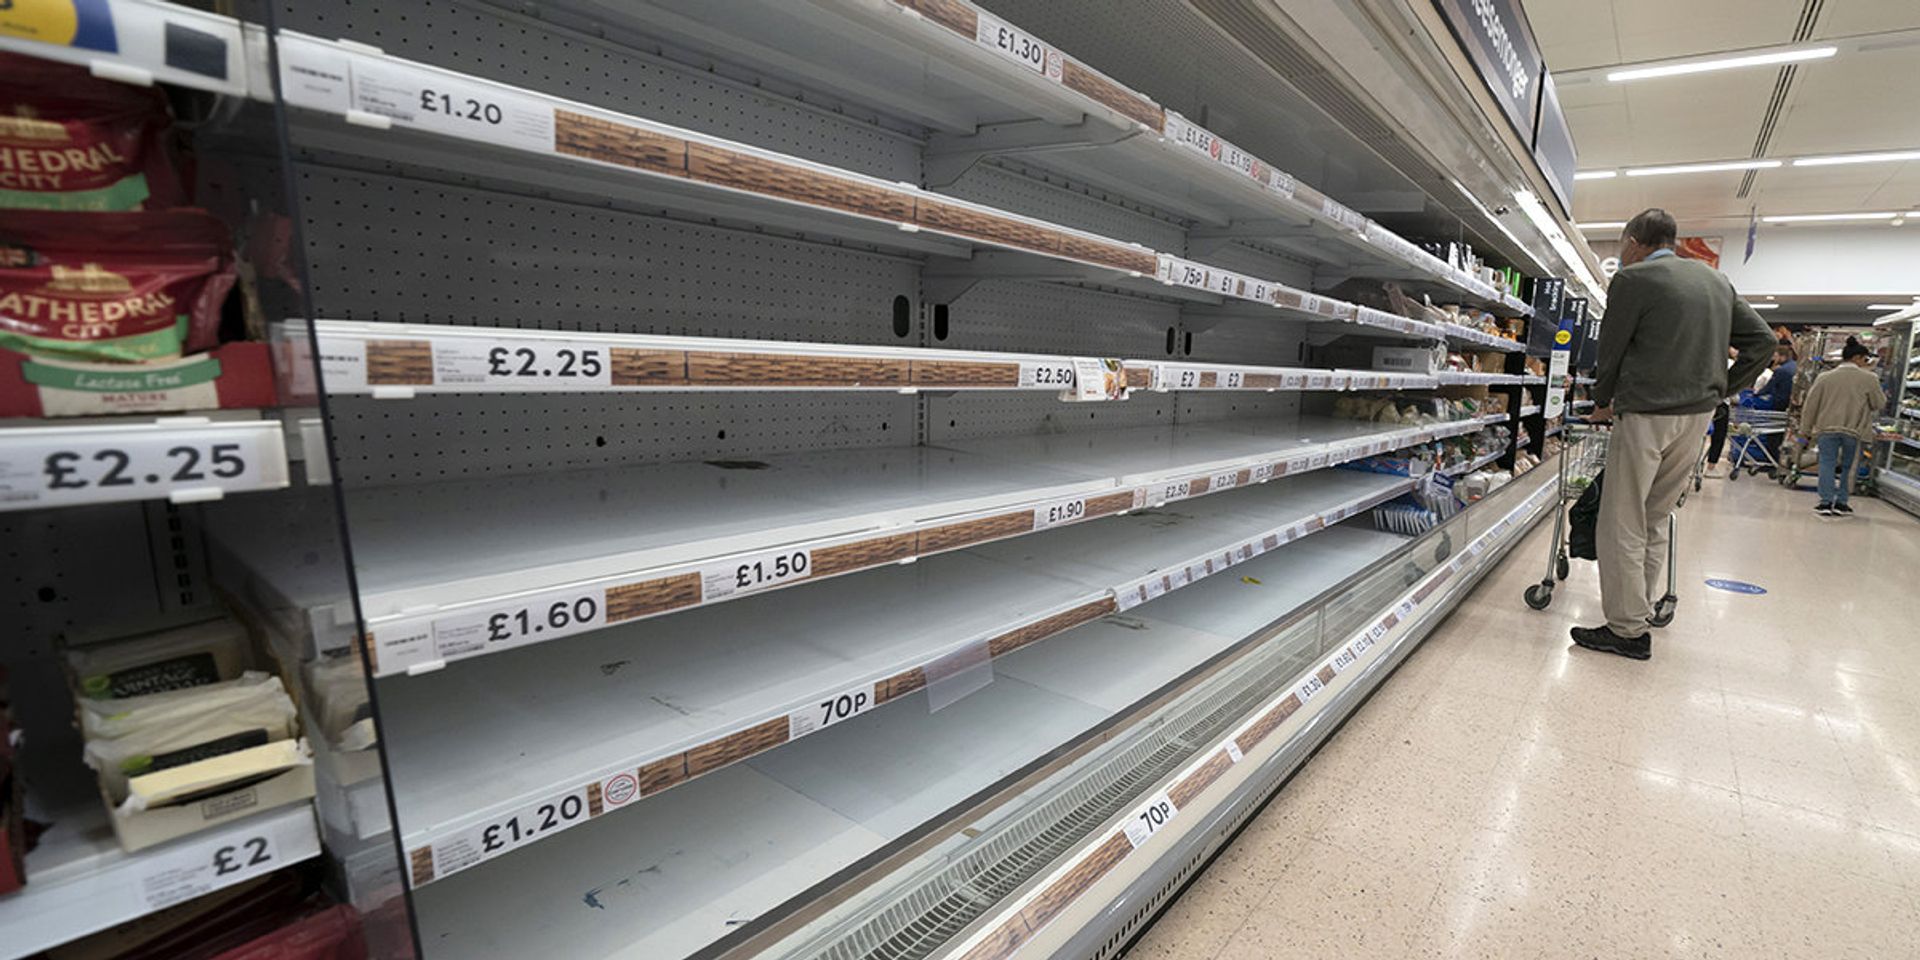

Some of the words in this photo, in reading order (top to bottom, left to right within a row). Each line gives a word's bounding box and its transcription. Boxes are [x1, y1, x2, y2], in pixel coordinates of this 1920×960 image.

[998, 27, 1041, 64] £1.30
[419, 89, 503, 125] £1.20
[0, 174, 62, 189] CITY
[1221, 276, 1232, 294] £1
[62, 321, 119, 339] CITY
[487, 347, 602, 378] £2.25
[1035, 367, 1072, 385] £2.50
[75, 372, 142, 389] Lactose
[146, 371, 182, 388] Free
[1180, 371, 1195, 388] £2
[1227, 372, 1240, 388] £2
[43, 443, 245, 490] £2.25
[1048, 500, 1083, 523] £1.90
[735, 551, 808, 588] £1.50
[487, 596, 598, 643] £1.60
[819, 691, 868, 726] 70p
[480, 794, 583, 854] £1.20
[1139, 799, 1170, 833] 70p
[211, 835, 272, 877] £2
